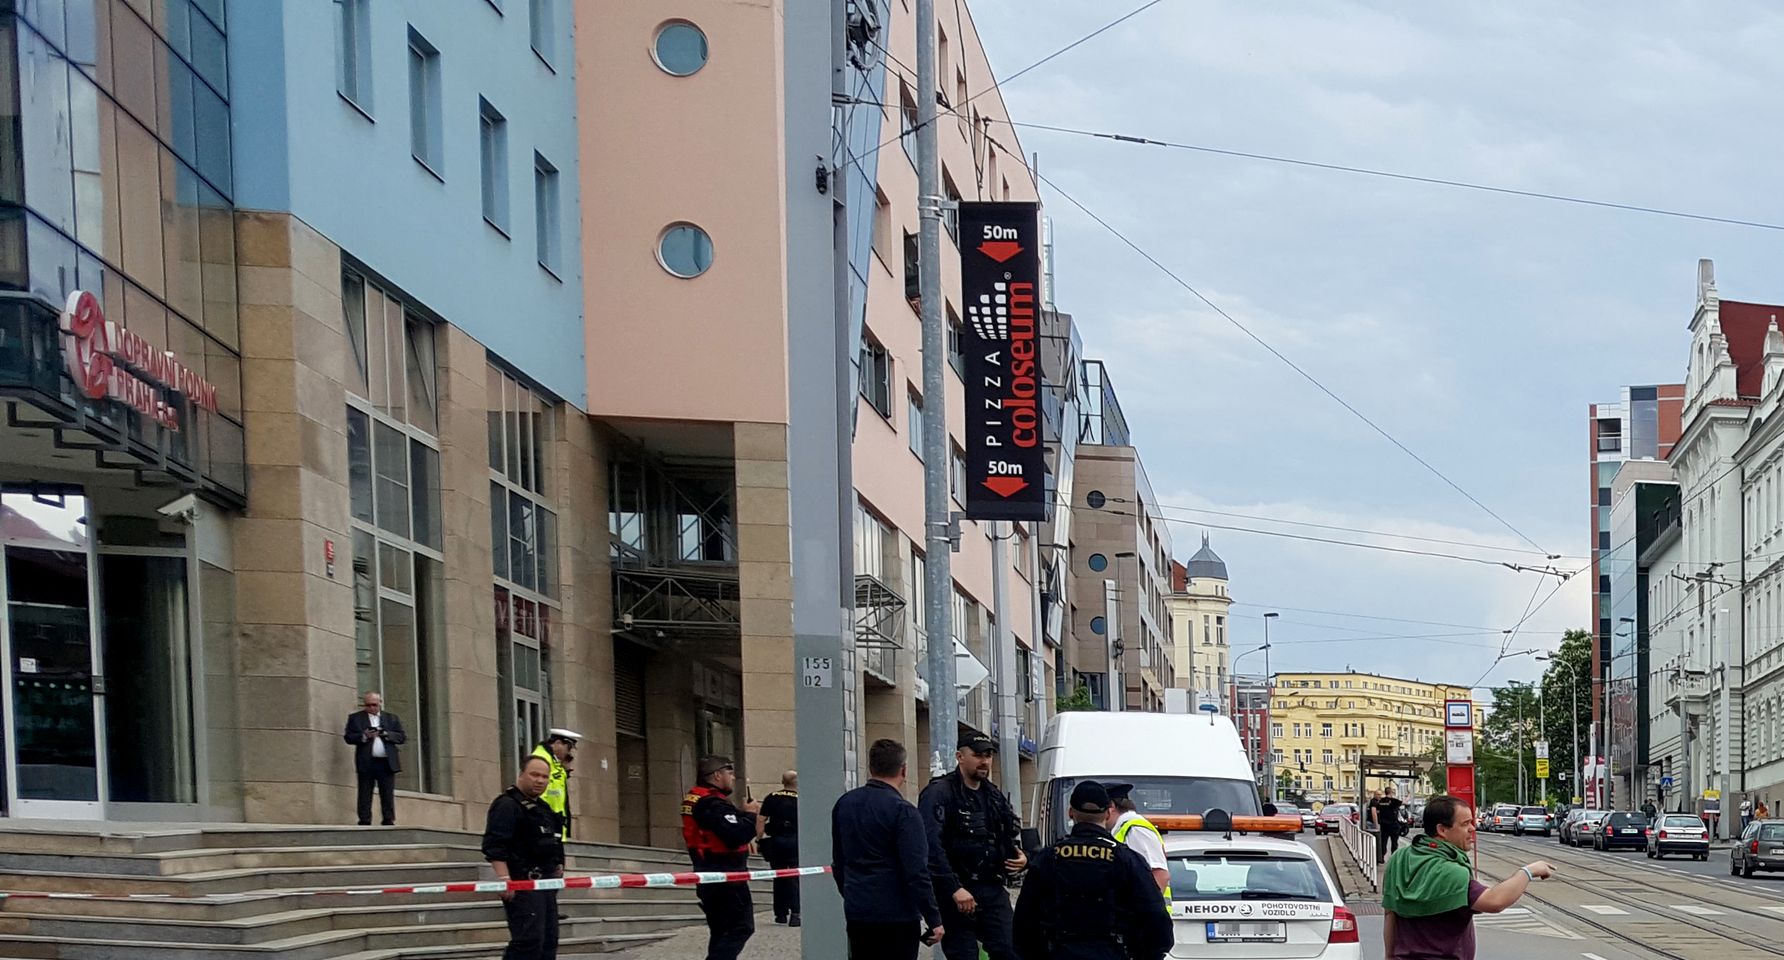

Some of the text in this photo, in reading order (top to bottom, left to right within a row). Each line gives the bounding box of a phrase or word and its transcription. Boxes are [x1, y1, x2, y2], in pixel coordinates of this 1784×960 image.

[983, 225, 1018, 240] 50m
[1002, 282, 1037, 448] coloseum
[985, 351, 1002, 447] PIZZA
[988, 461, 1022, 475] 50m
[805, 658, 830, 670] 155
[804, 675, 821, 687] 02
[1054, 844, 1115, 862] POLICIE
[1184, 905, 1236, 914] NEHODY
